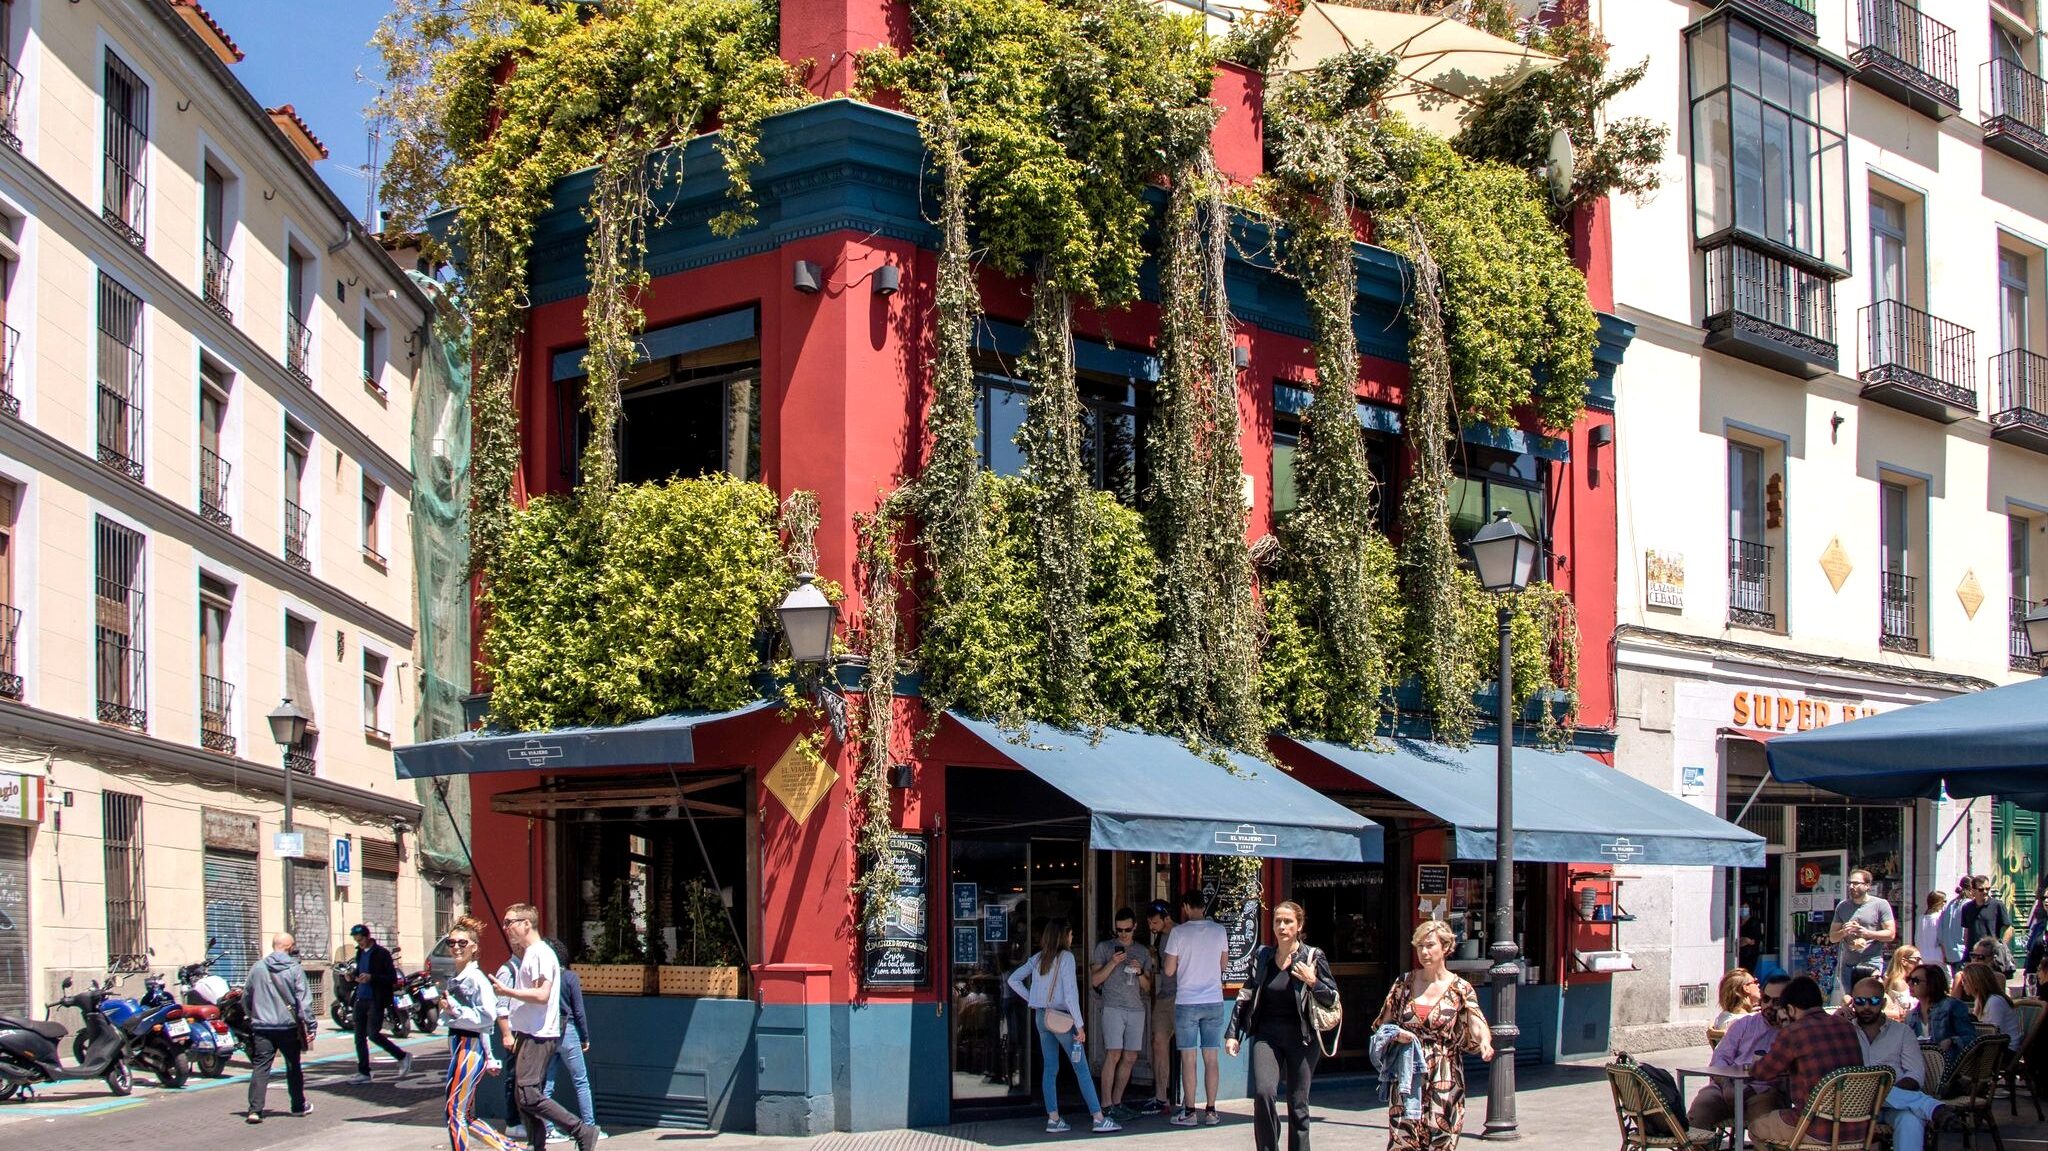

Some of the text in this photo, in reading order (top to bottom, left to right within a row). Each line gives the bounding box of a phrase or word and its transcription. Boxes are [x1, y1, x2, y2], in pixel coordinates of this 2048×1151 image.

[1650, 592, 1683, 606] CEBADA
[1734, 691, 1830, 731] SUPER
[883, 951, 906, 962] Enjoy
[877, 959, 887, 968] the
